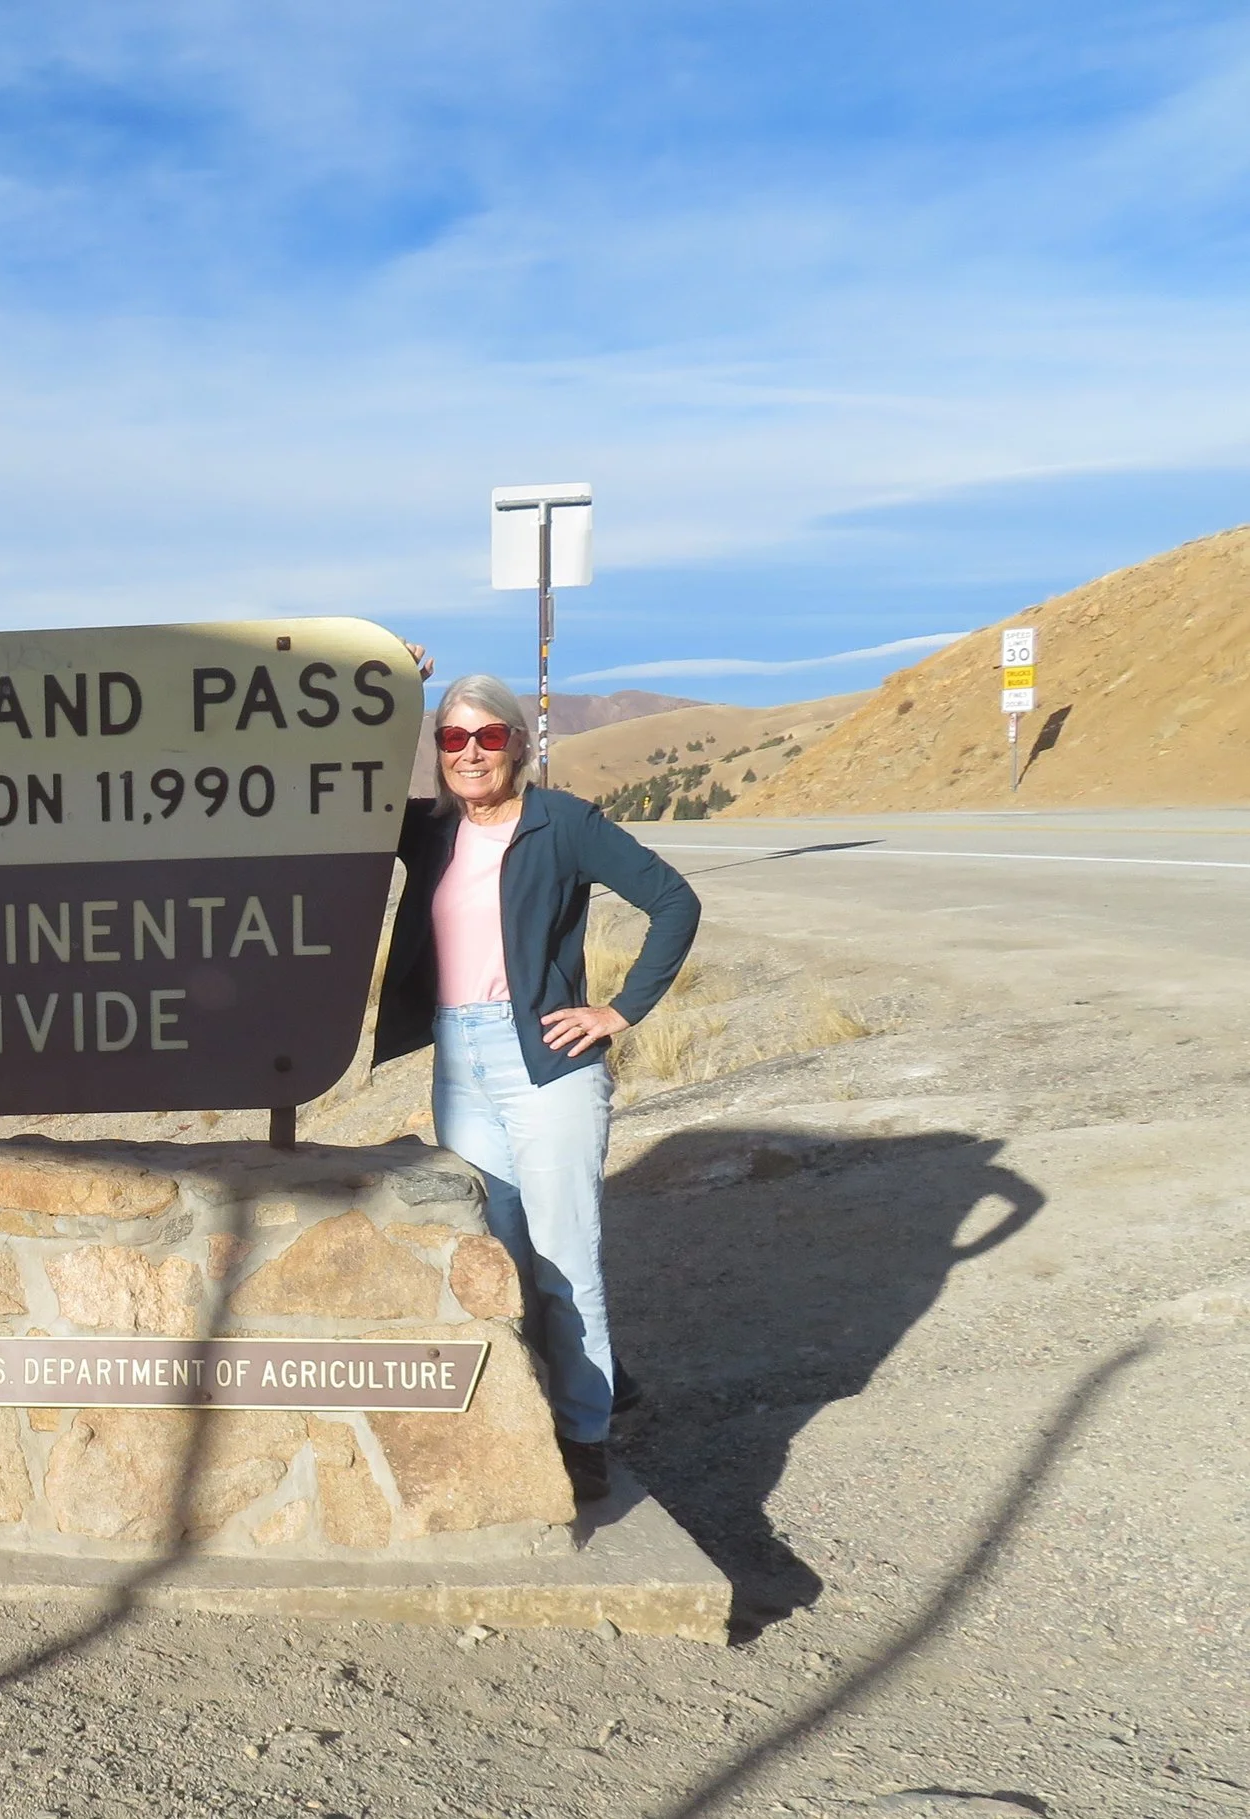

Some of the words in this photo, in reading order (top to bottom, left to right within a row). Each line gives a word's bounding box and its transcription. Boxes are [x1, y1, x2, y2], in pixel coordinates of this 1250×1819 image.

[1006, 648, 1030, 662] 30
[192, 660, 395, 732] PASS
[96, 764, 276, 826] 11,990
[310, 761, 395, 815] FT.
[24, 1358, 206, 1388] DEPARTMENT
[215, 1360, 250, 1389] OF
[261, 1360, 456, 1390] AGRICULTURE
